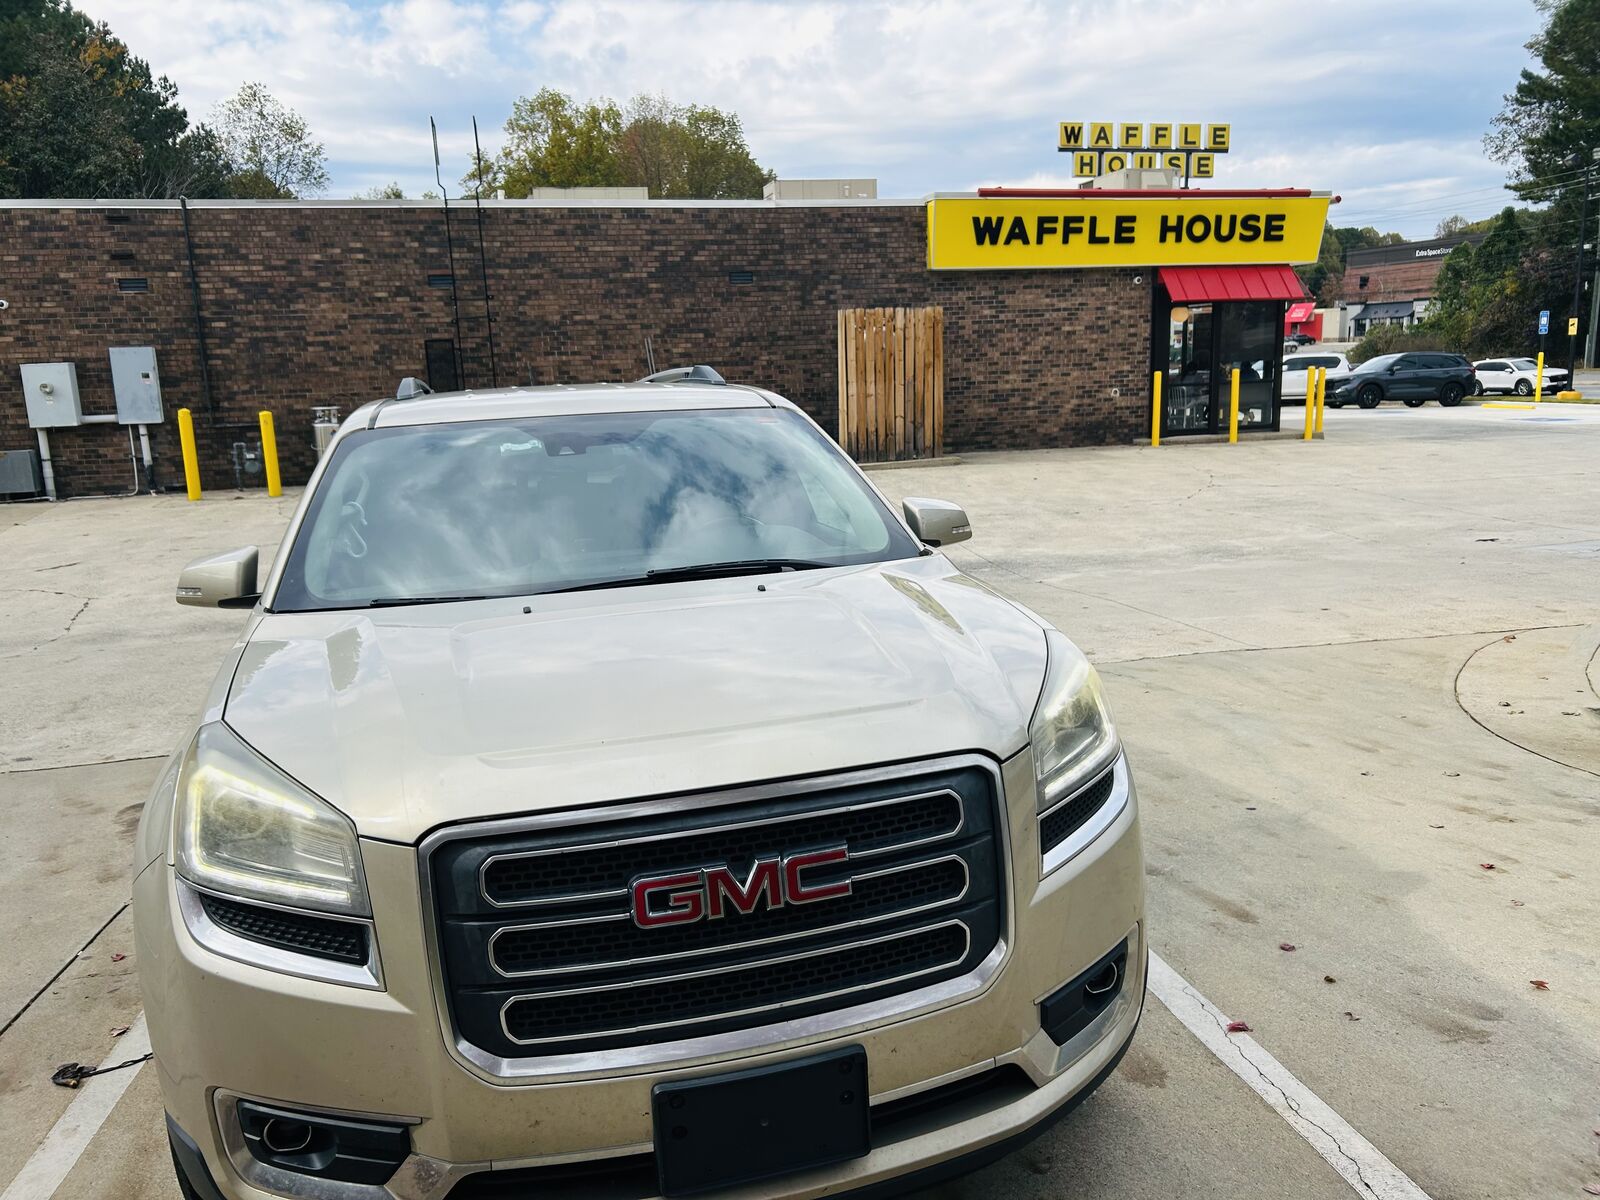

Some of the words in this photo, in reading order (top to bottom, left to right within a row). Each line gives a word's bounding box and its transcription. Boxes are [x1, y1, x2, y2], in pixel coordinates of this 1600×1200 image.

[1064, 126, 1227, 145] WAFFLE
[1079, 155, 1211, 174] HOUSE
[972, 216, 1137, 245] WAFFLE
[1159, 214, 1286, 243] HOUSE
[632, 842, 852, 930] GMC
